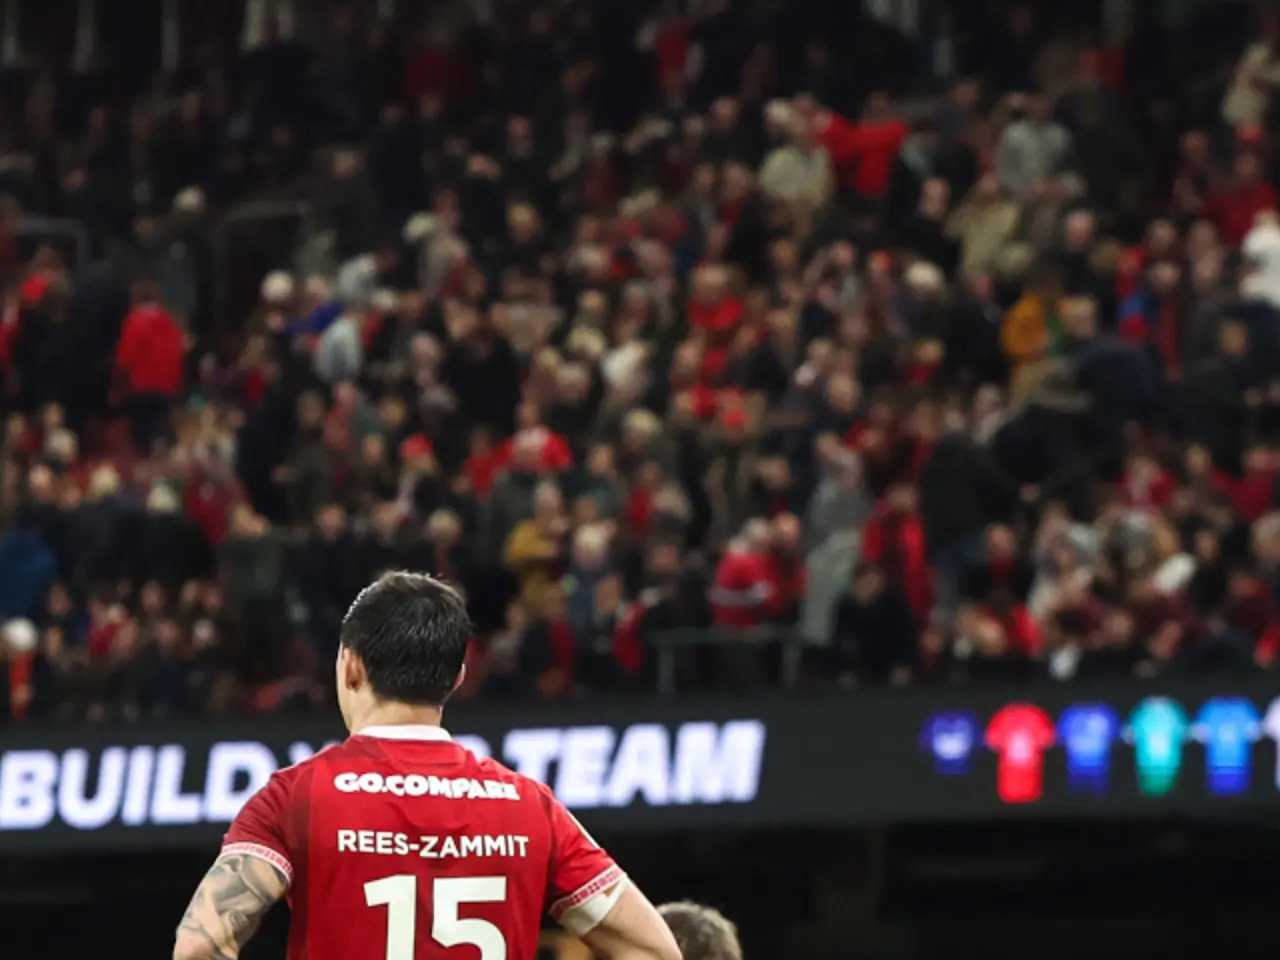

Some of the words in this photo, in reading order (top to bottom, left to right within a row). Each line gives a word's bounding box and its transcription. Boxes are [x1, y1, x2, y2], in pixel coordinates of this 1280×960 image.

[503, 719, 766, 808] TEAM
[334, 772, 520, 800] GO.COMPARE
[337, 829, 529, 859] REES-ZAMMIT
